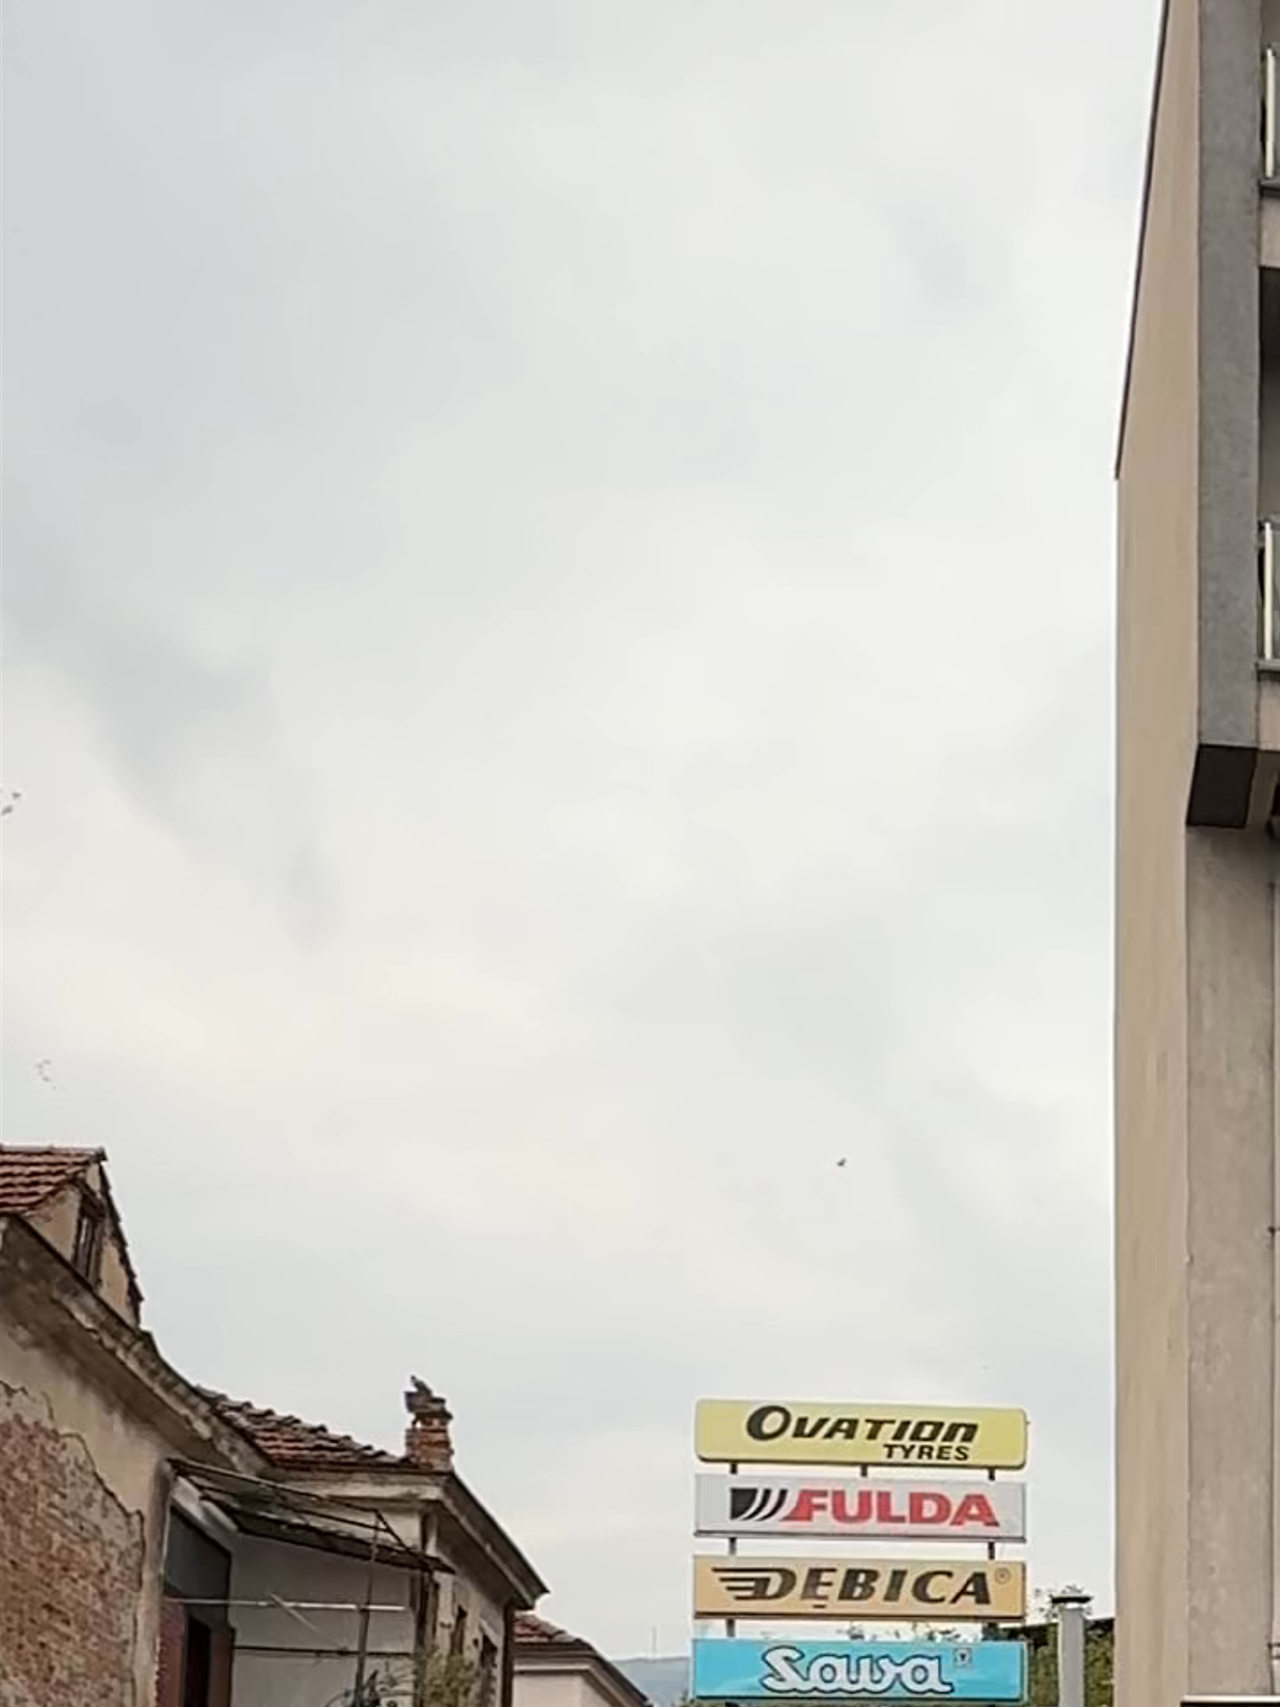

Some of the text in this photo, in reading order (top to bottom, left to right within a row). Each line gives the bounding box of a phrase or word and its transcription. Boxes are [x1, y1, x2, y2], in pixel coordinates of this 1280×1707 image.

[746, 1405, 978, 1443] OVATION
[883, 1444, 970, 1461] TYRES
[780, 1489, 1000, 1527] FULDA
[761, 1645, 955, 1695] Sava
